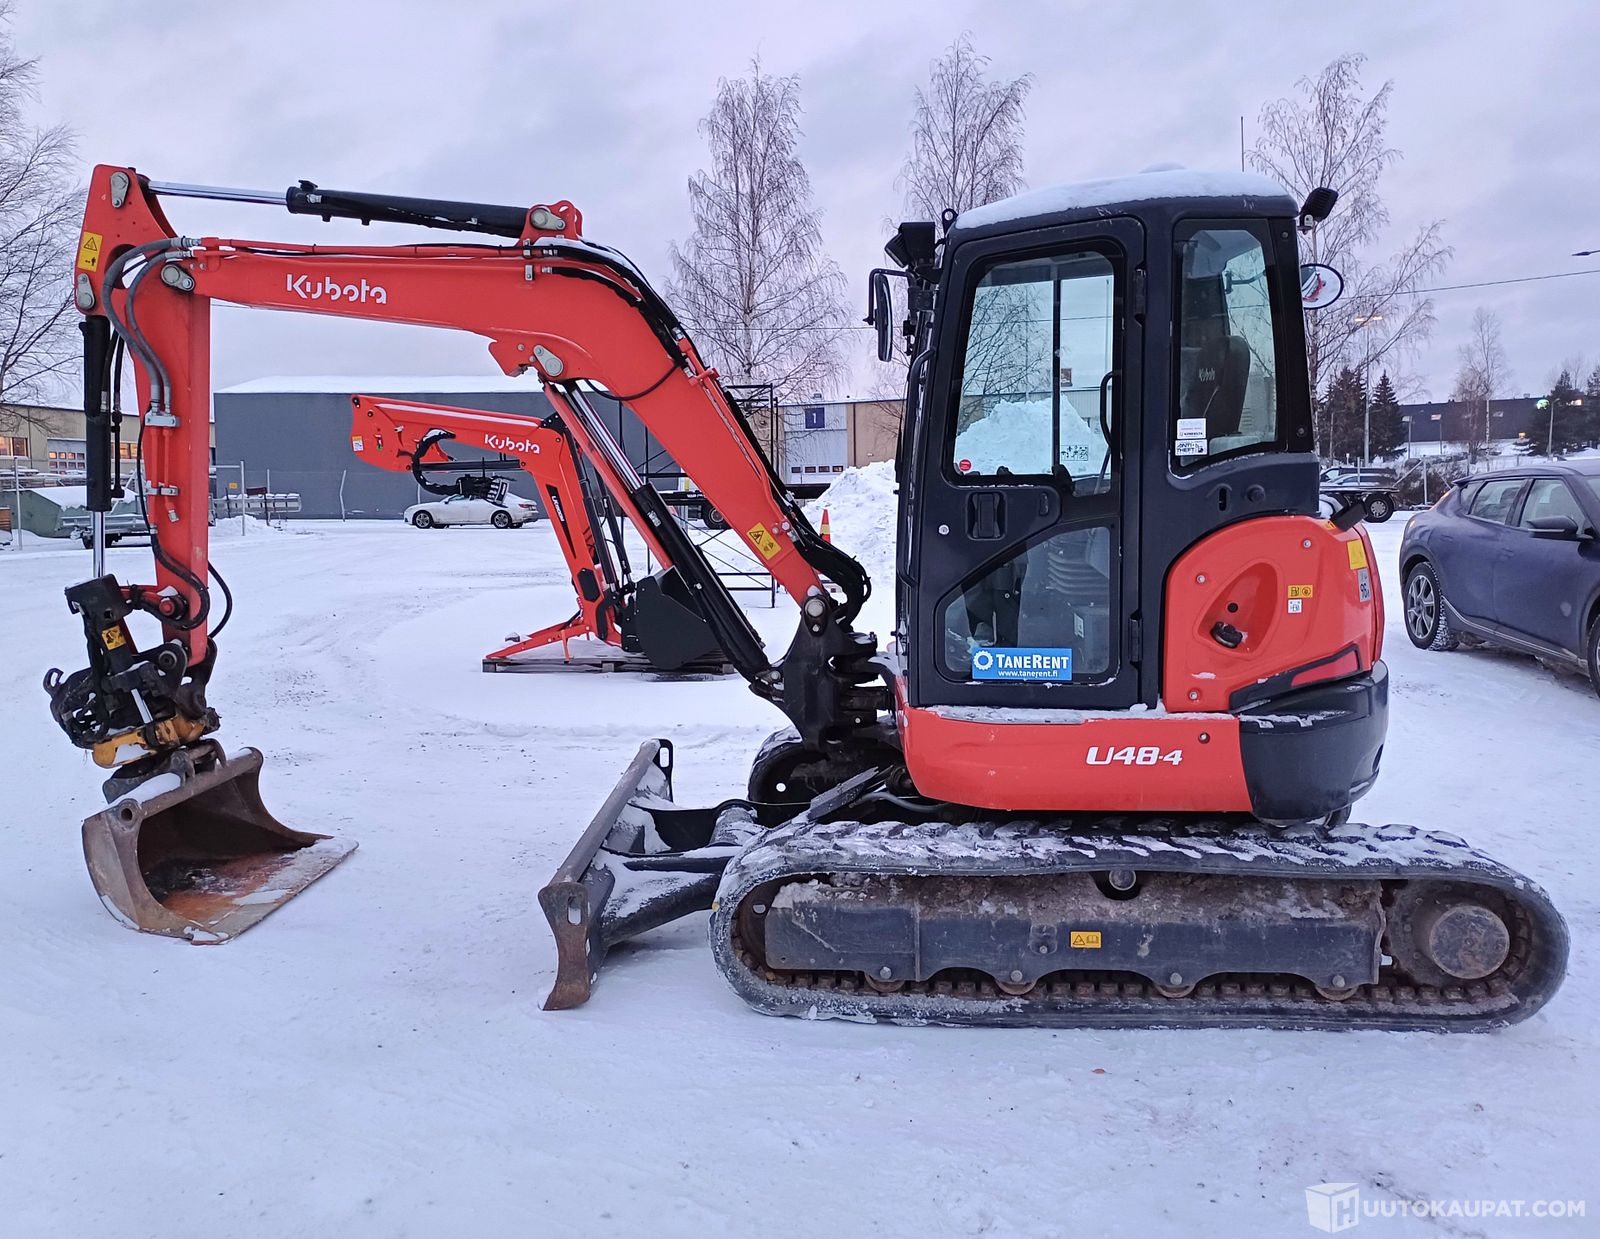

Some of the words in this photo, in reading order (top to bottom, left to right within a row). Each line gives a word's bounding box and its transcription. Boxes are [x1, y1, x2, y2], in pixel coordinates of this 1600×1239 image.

[286, 273, 387, 305] Kubota
[484, 433, 540, 455] Kubota
[998, 669, 1058, 679] www.tanerent.fi
[1085, 746, 1183, 766] U48-4
